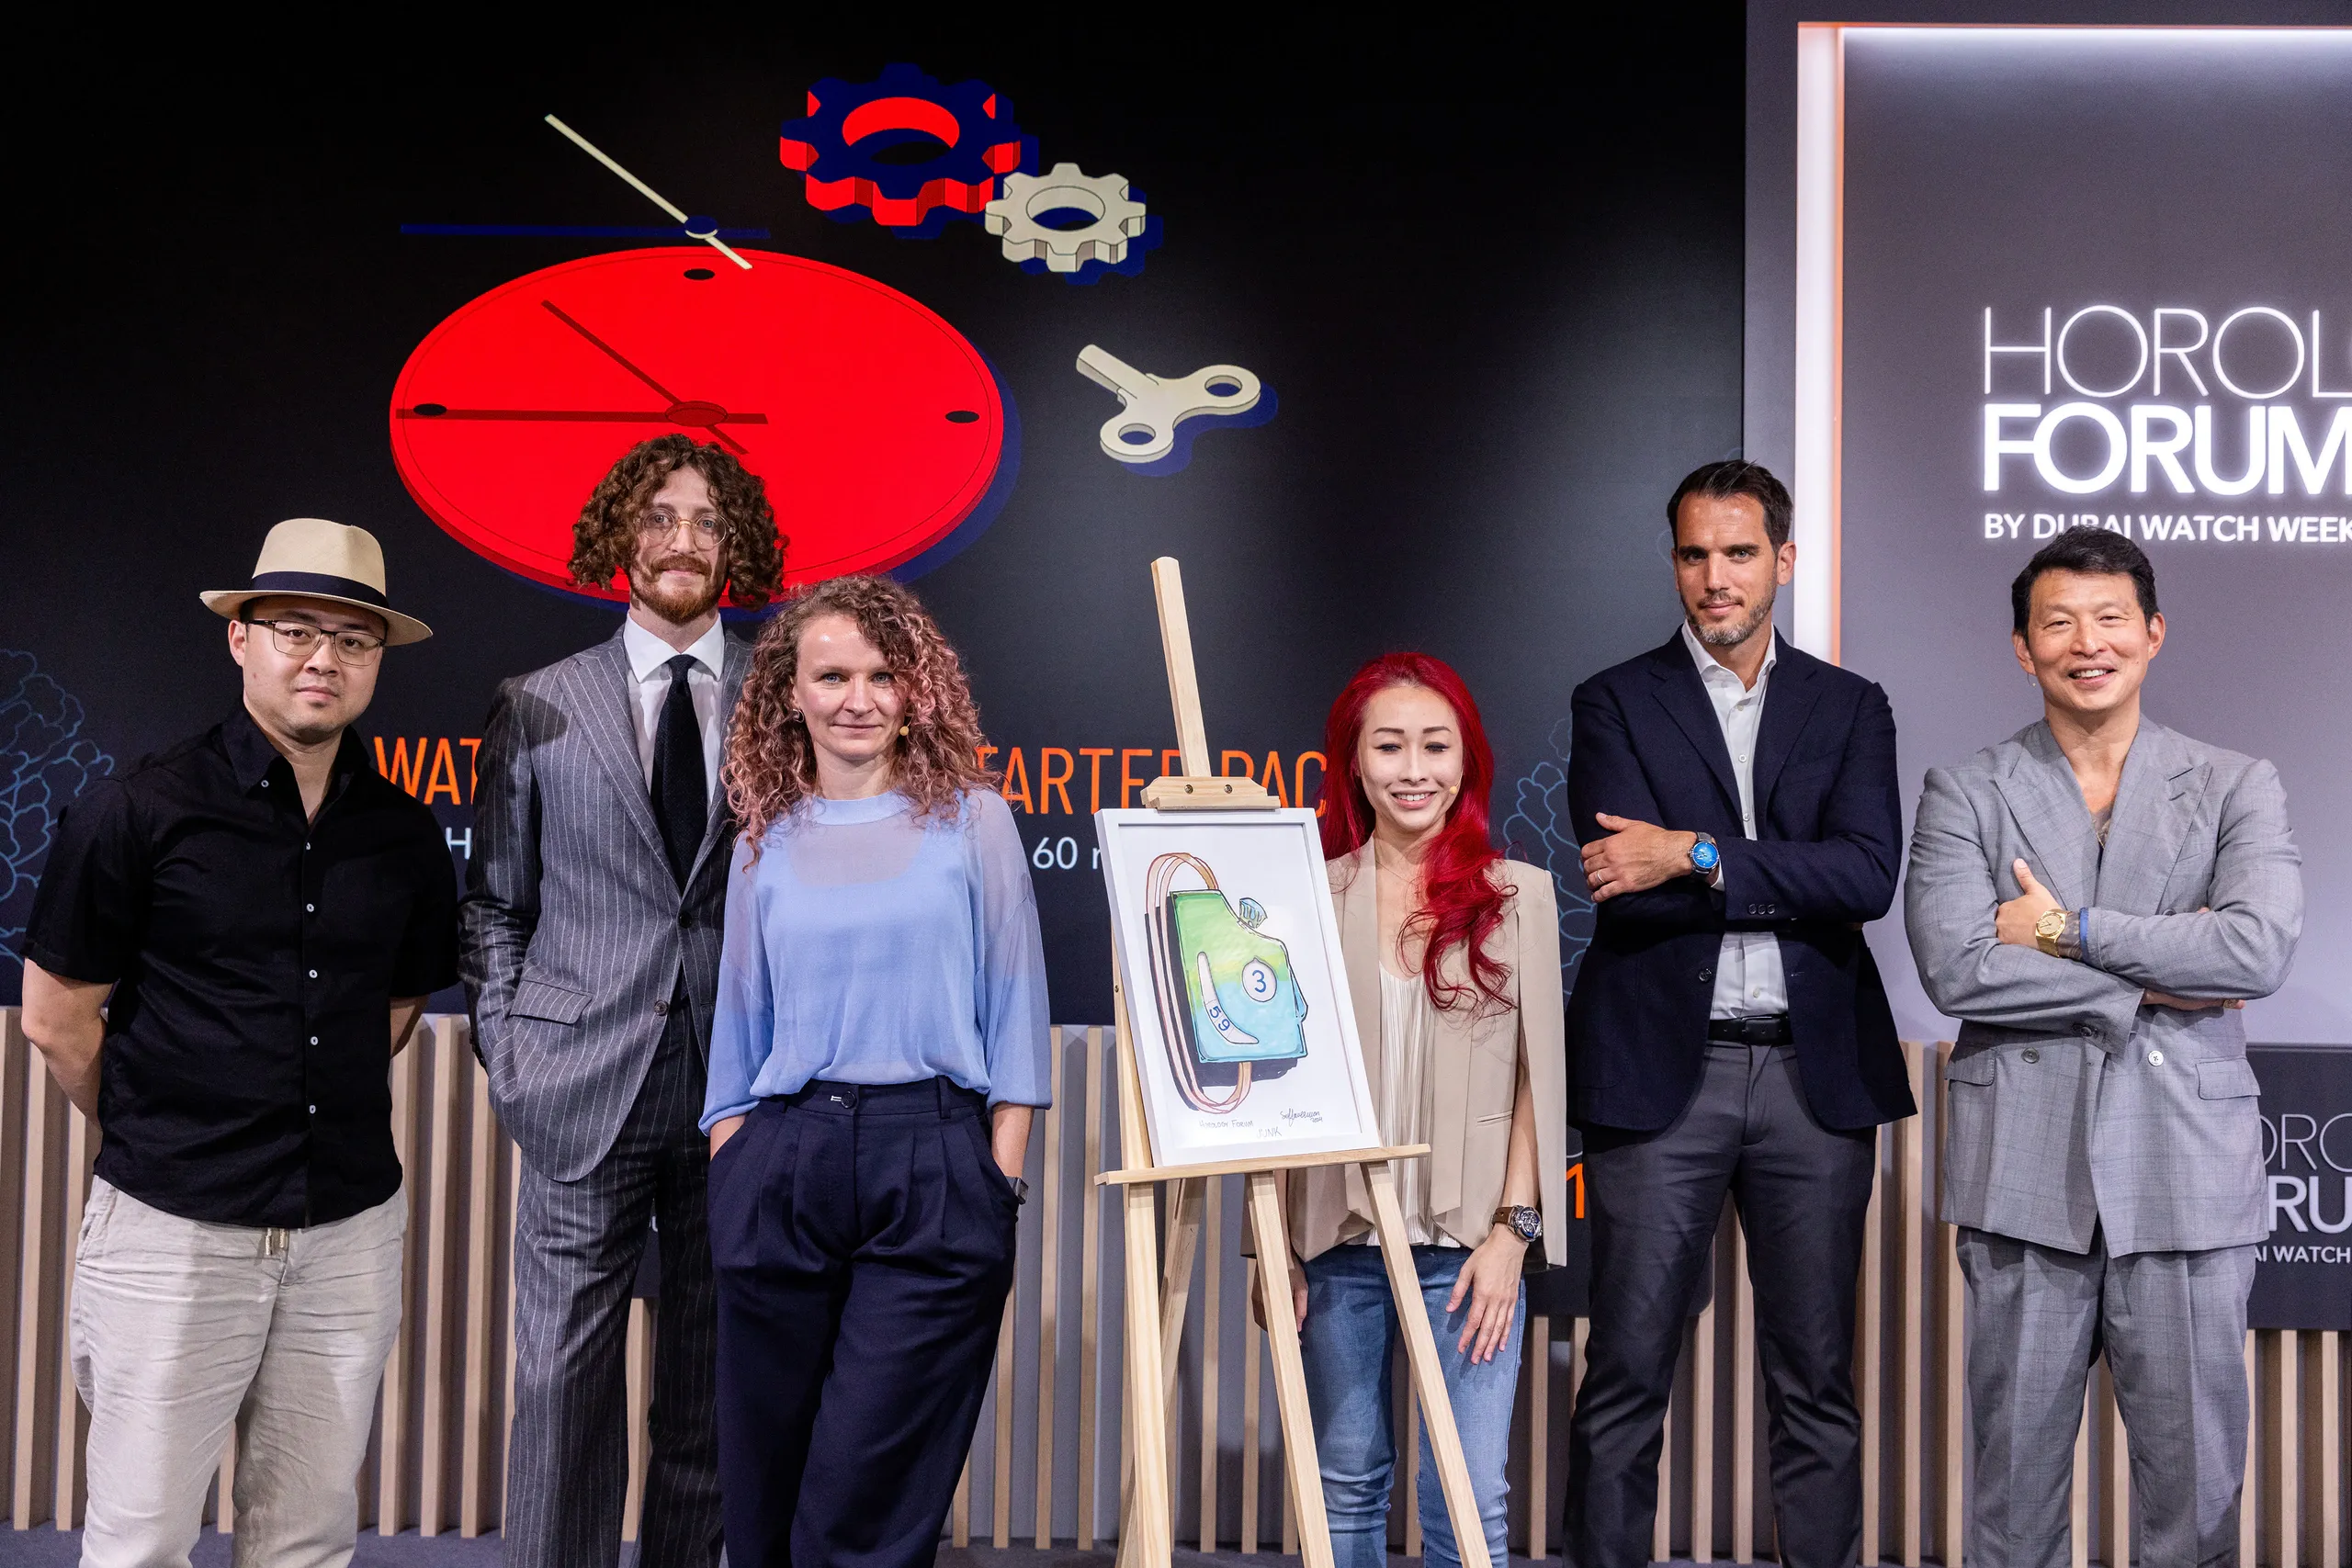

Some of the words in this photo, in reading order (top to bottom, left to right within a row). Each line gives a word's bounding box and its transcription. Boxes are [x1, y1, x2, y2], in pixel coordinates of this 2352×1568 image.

[1983, 401, 2352, 496] FORUM
[1984, 513, 2026, 540] BY
[2139, 514, 2260, 542] WATCH
[2267, 516, 2352, 544] WEEK
[1032, 836, 1079, 870] 60
[1251, 969, 1267, 993] 3
[2273, 1245, 2351, 1264] WATCH
